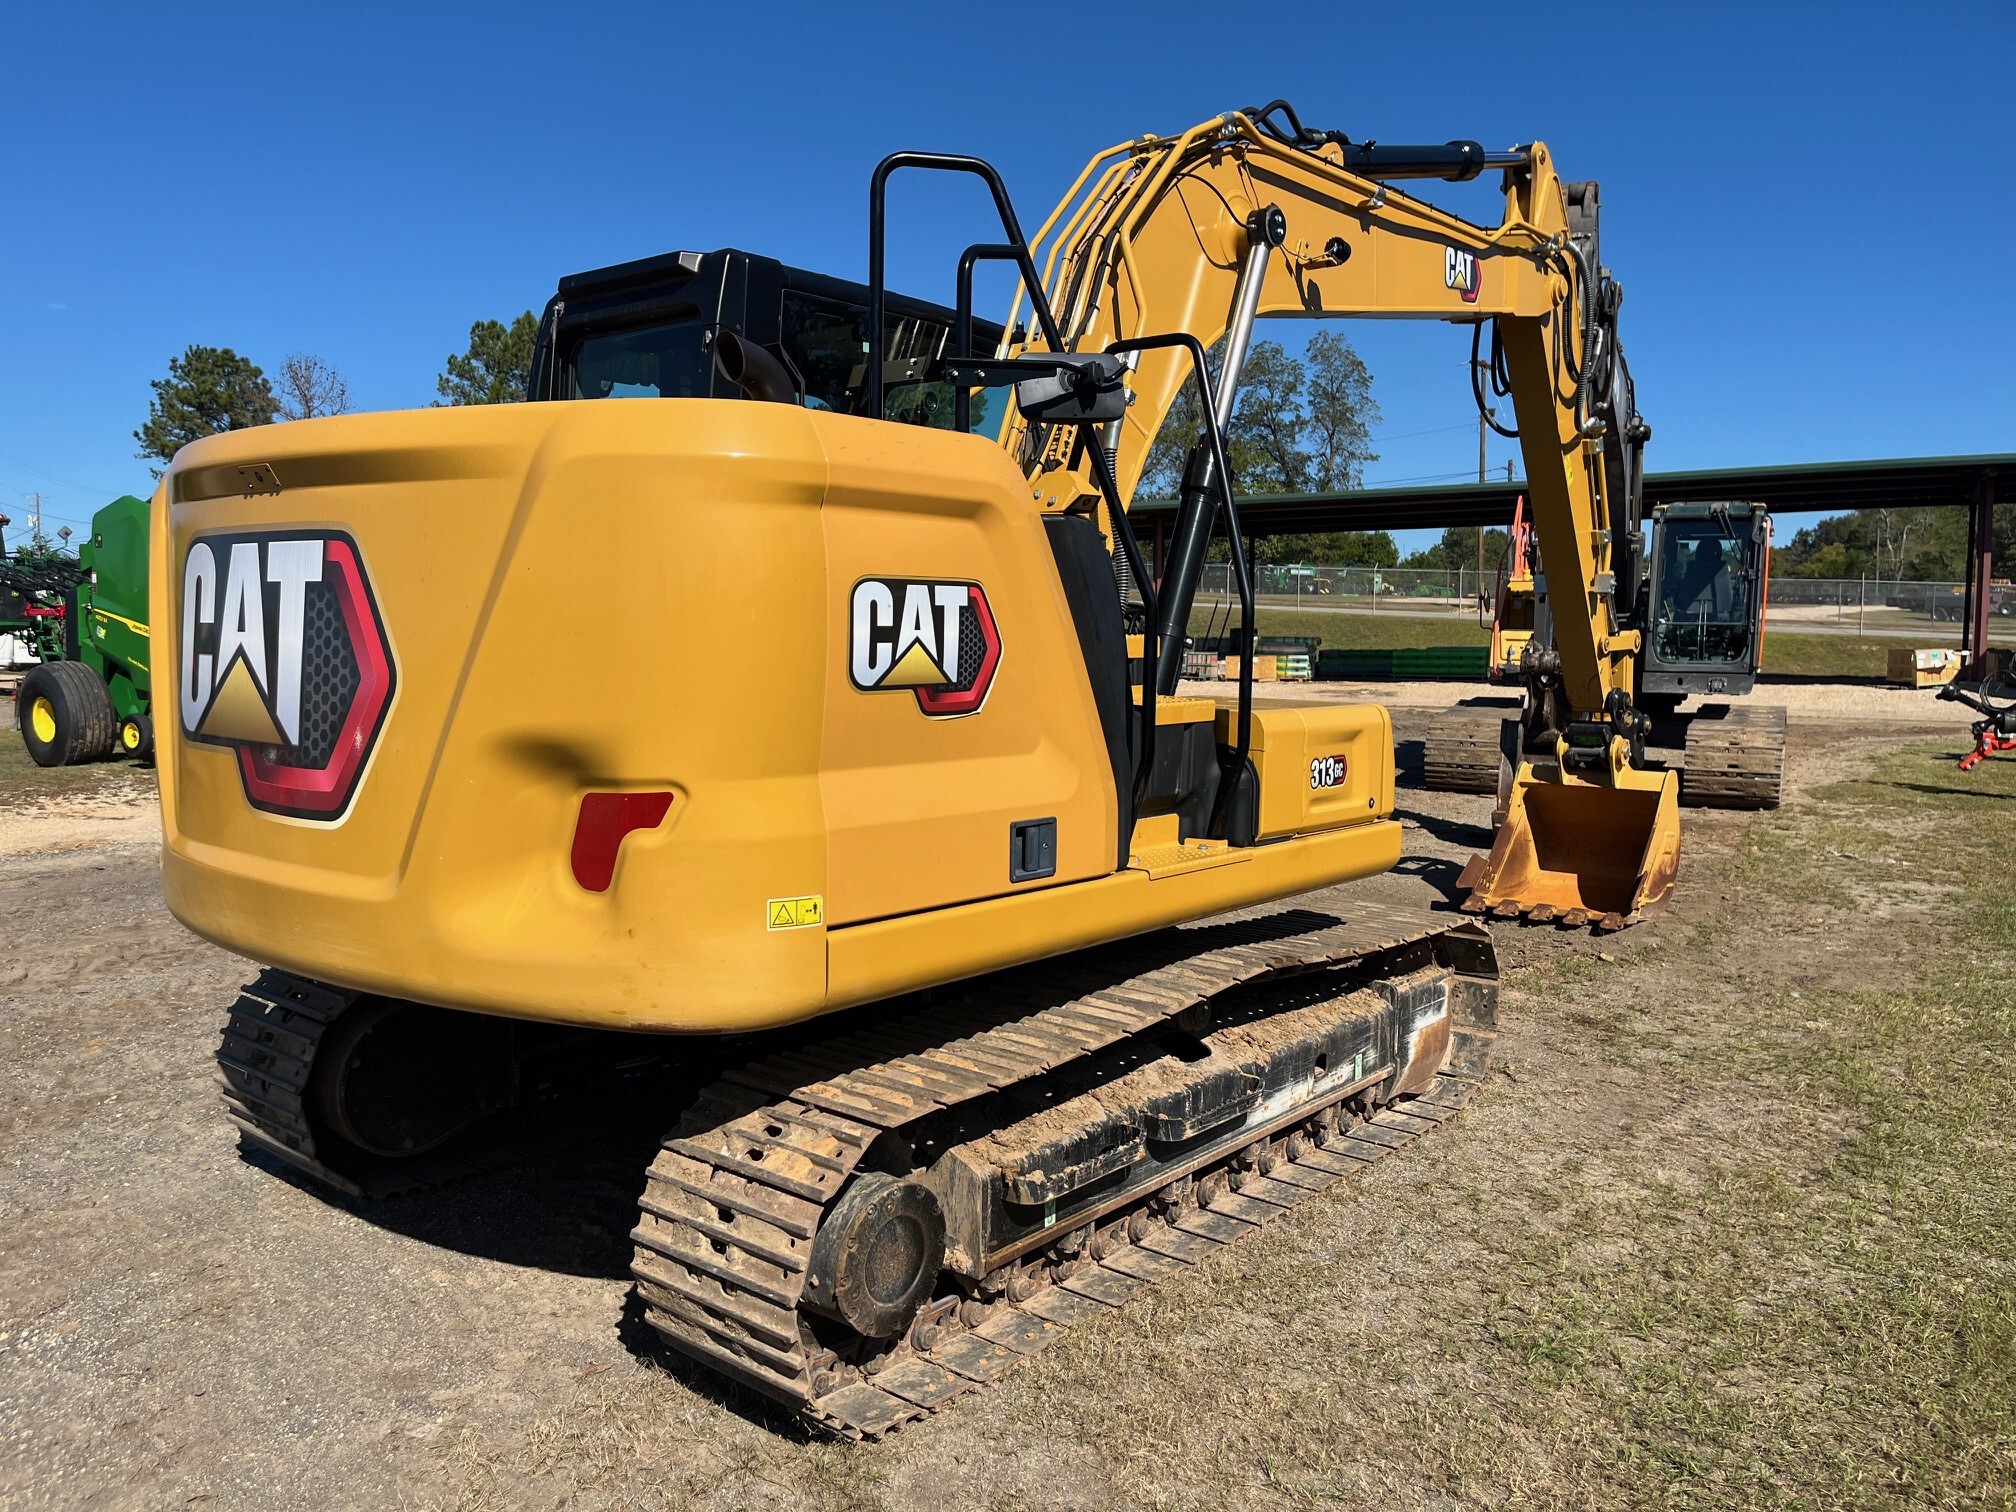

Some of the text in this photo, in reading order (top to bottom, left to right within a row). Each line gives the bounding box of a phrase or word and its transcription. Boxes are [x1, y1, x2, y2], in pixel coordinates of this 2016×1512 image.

[1445, 246, 1474, 290] CAT
[181, 540, 324, 746] CAT
[852, 581, 968, 686] CAT
[1310, 757, 1344, 788] 313 GC
